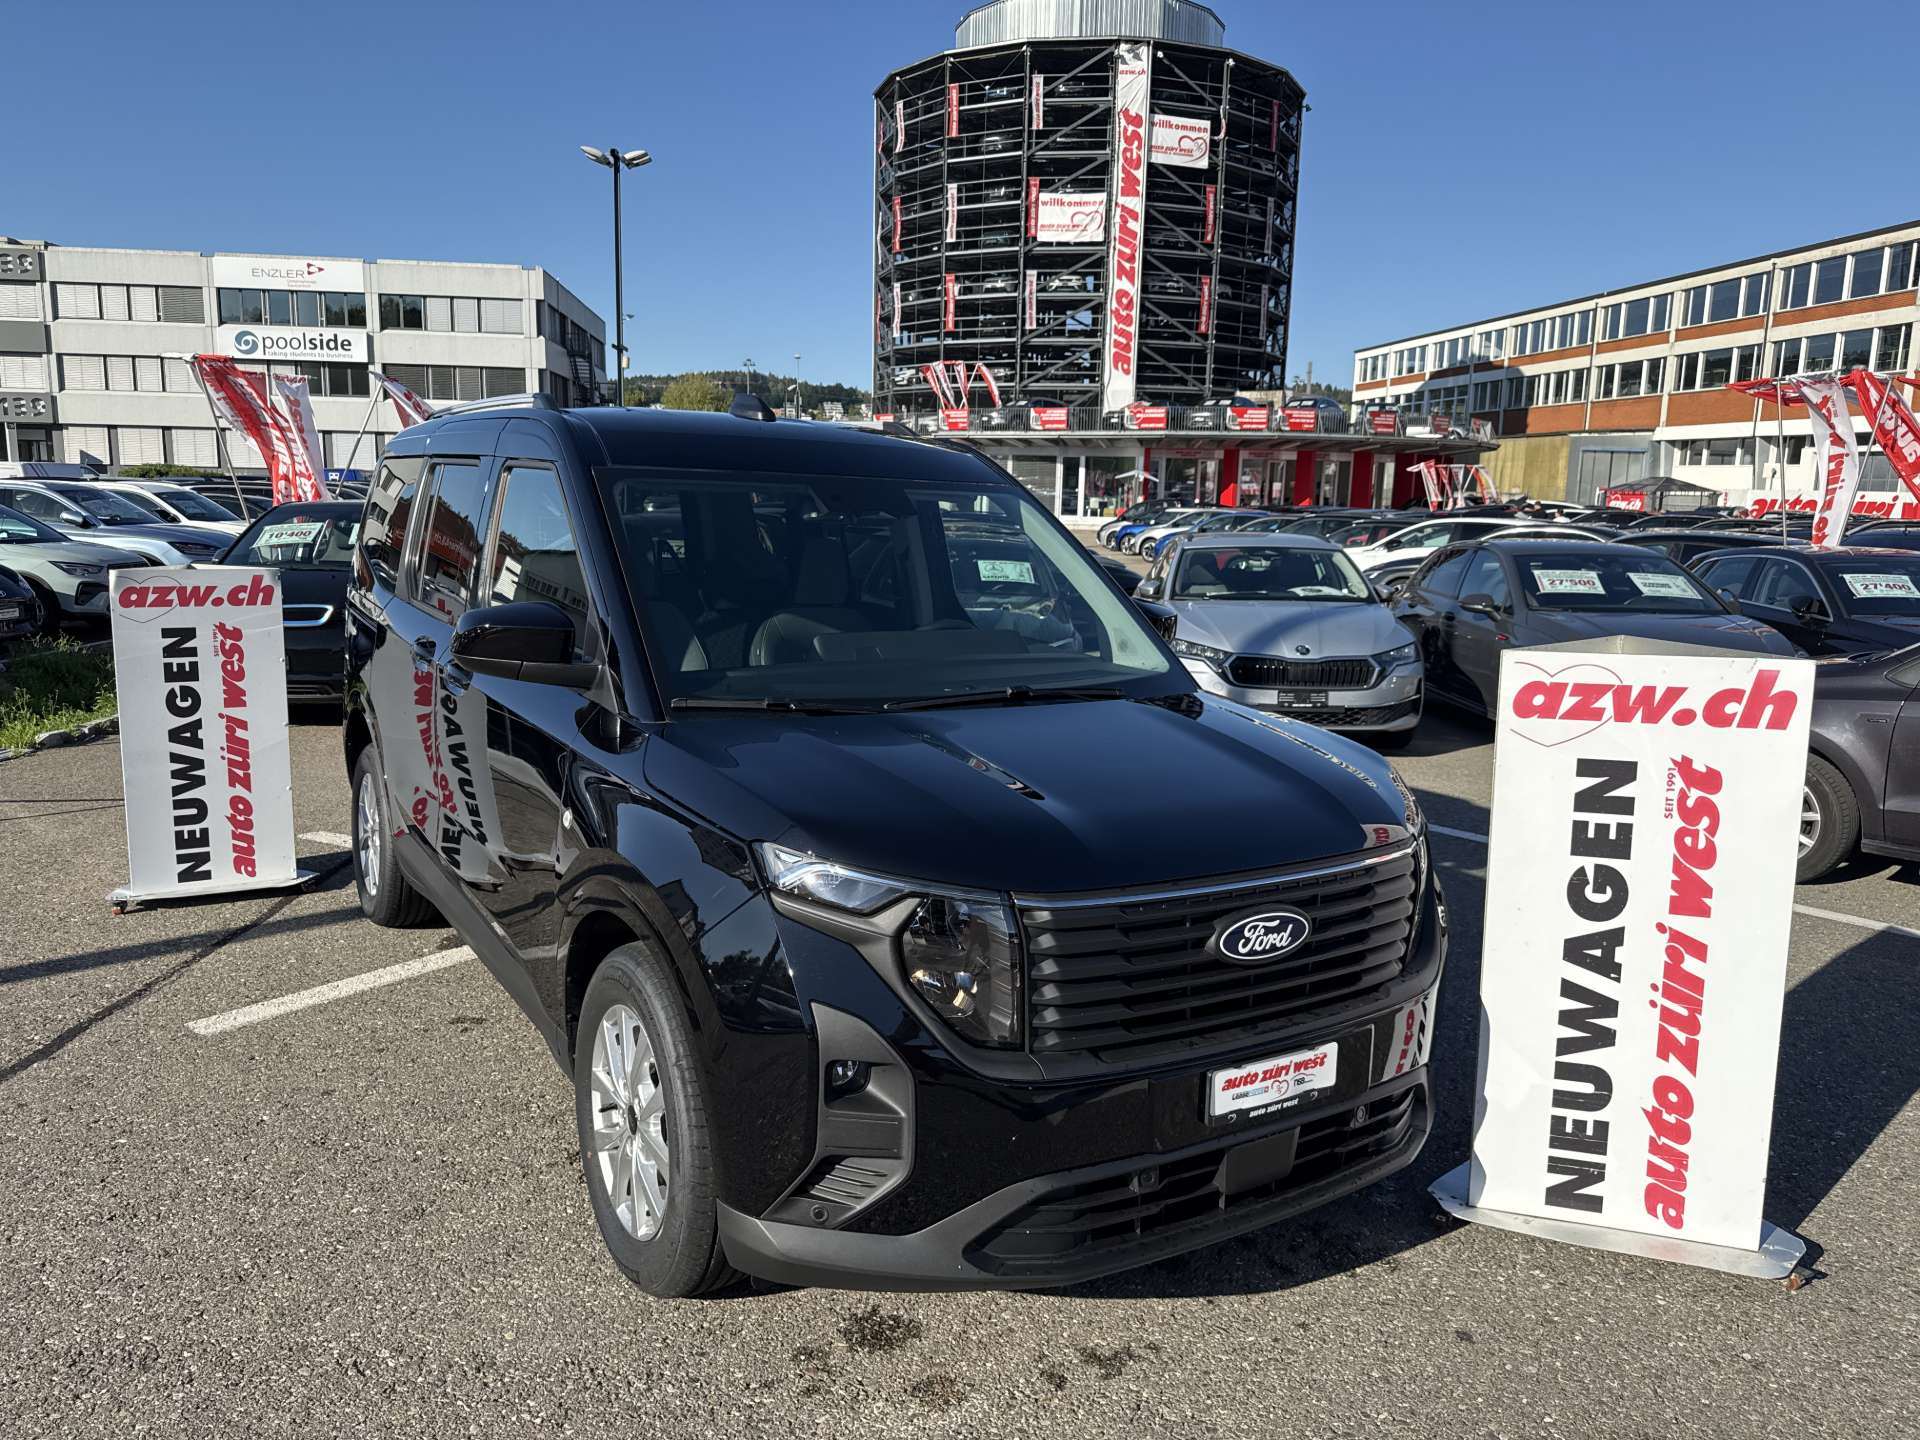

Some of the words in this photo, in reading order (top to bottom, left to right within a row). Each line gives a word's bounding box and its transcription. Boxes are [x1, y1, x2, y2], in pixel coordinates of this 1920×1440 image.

[1119, 107, 1144, 197] west
[251, 268, 305, 279] ENZLER
[262, 331, 352, 356] poolside
[1111, 288, 1134, 376] auto
[268, 350, 288, 358] taking
[290, 350, 317, 358] students
[326, 351, 353, 359] business
[268, 530, 312, 539] 10'400
[119, 574, 275, 609] azw.ch
[1548, 578, 1597, 587] 27'500
[1860, 583, 1911, 591] 27'400
[213, 621, 249, 709] west
[1512, 669, 1798, 731] azw.ch
[161, 627, 213, 884] NEUWAGEN
[218, 712, 253, 793] züri
[1665, 767, 1677, 792] 1991
[1664, 797, 1675, 820] SEIT
[224, 795, 257, 878] auto
[1669, 754, 1725, 918] west
[1238, 919, 1294, 954] Ford
[1544, 758, 1639, 1214] NEUWAGEN
[1649, 922, 1709, 1078] züri
[1221, 1070, 1259, 1092] auto
[1259, 1060, 1293, 1082] züri
[1292, 1052, 1328, 1074] west
[1249, 1107, 1266, 1118] auto
[1266, 1101, 1283, 1113] züri
[1283, 1097, 1299, 1108] west
[1640, 1076, 1695, 1231] auto
